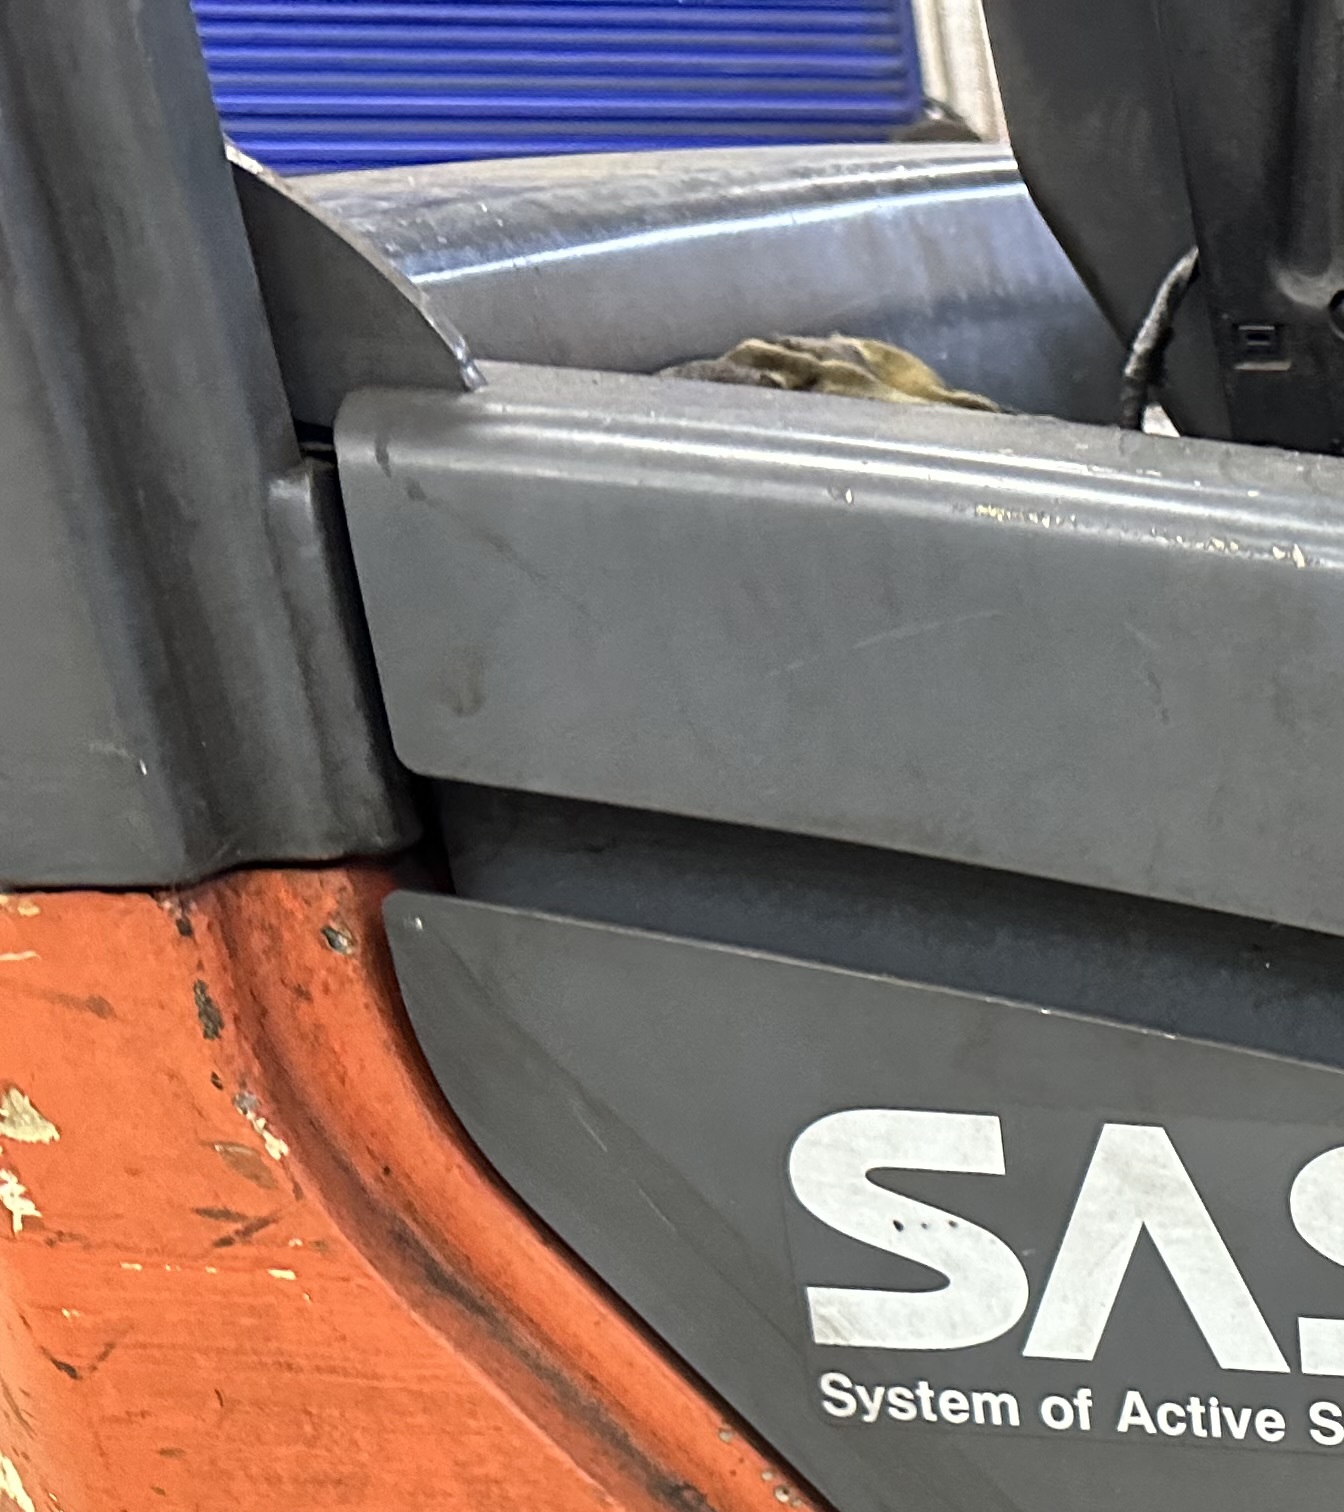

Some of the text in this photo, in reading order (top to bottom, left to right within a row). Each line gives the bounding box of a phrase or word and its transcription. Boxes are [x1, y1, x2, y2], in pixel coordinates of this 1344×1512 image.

[819, 1371, 1021, 1427] System
[1040, 1388, 1093, 1431] of
[1116, 1390, 1286, 1443] Active
